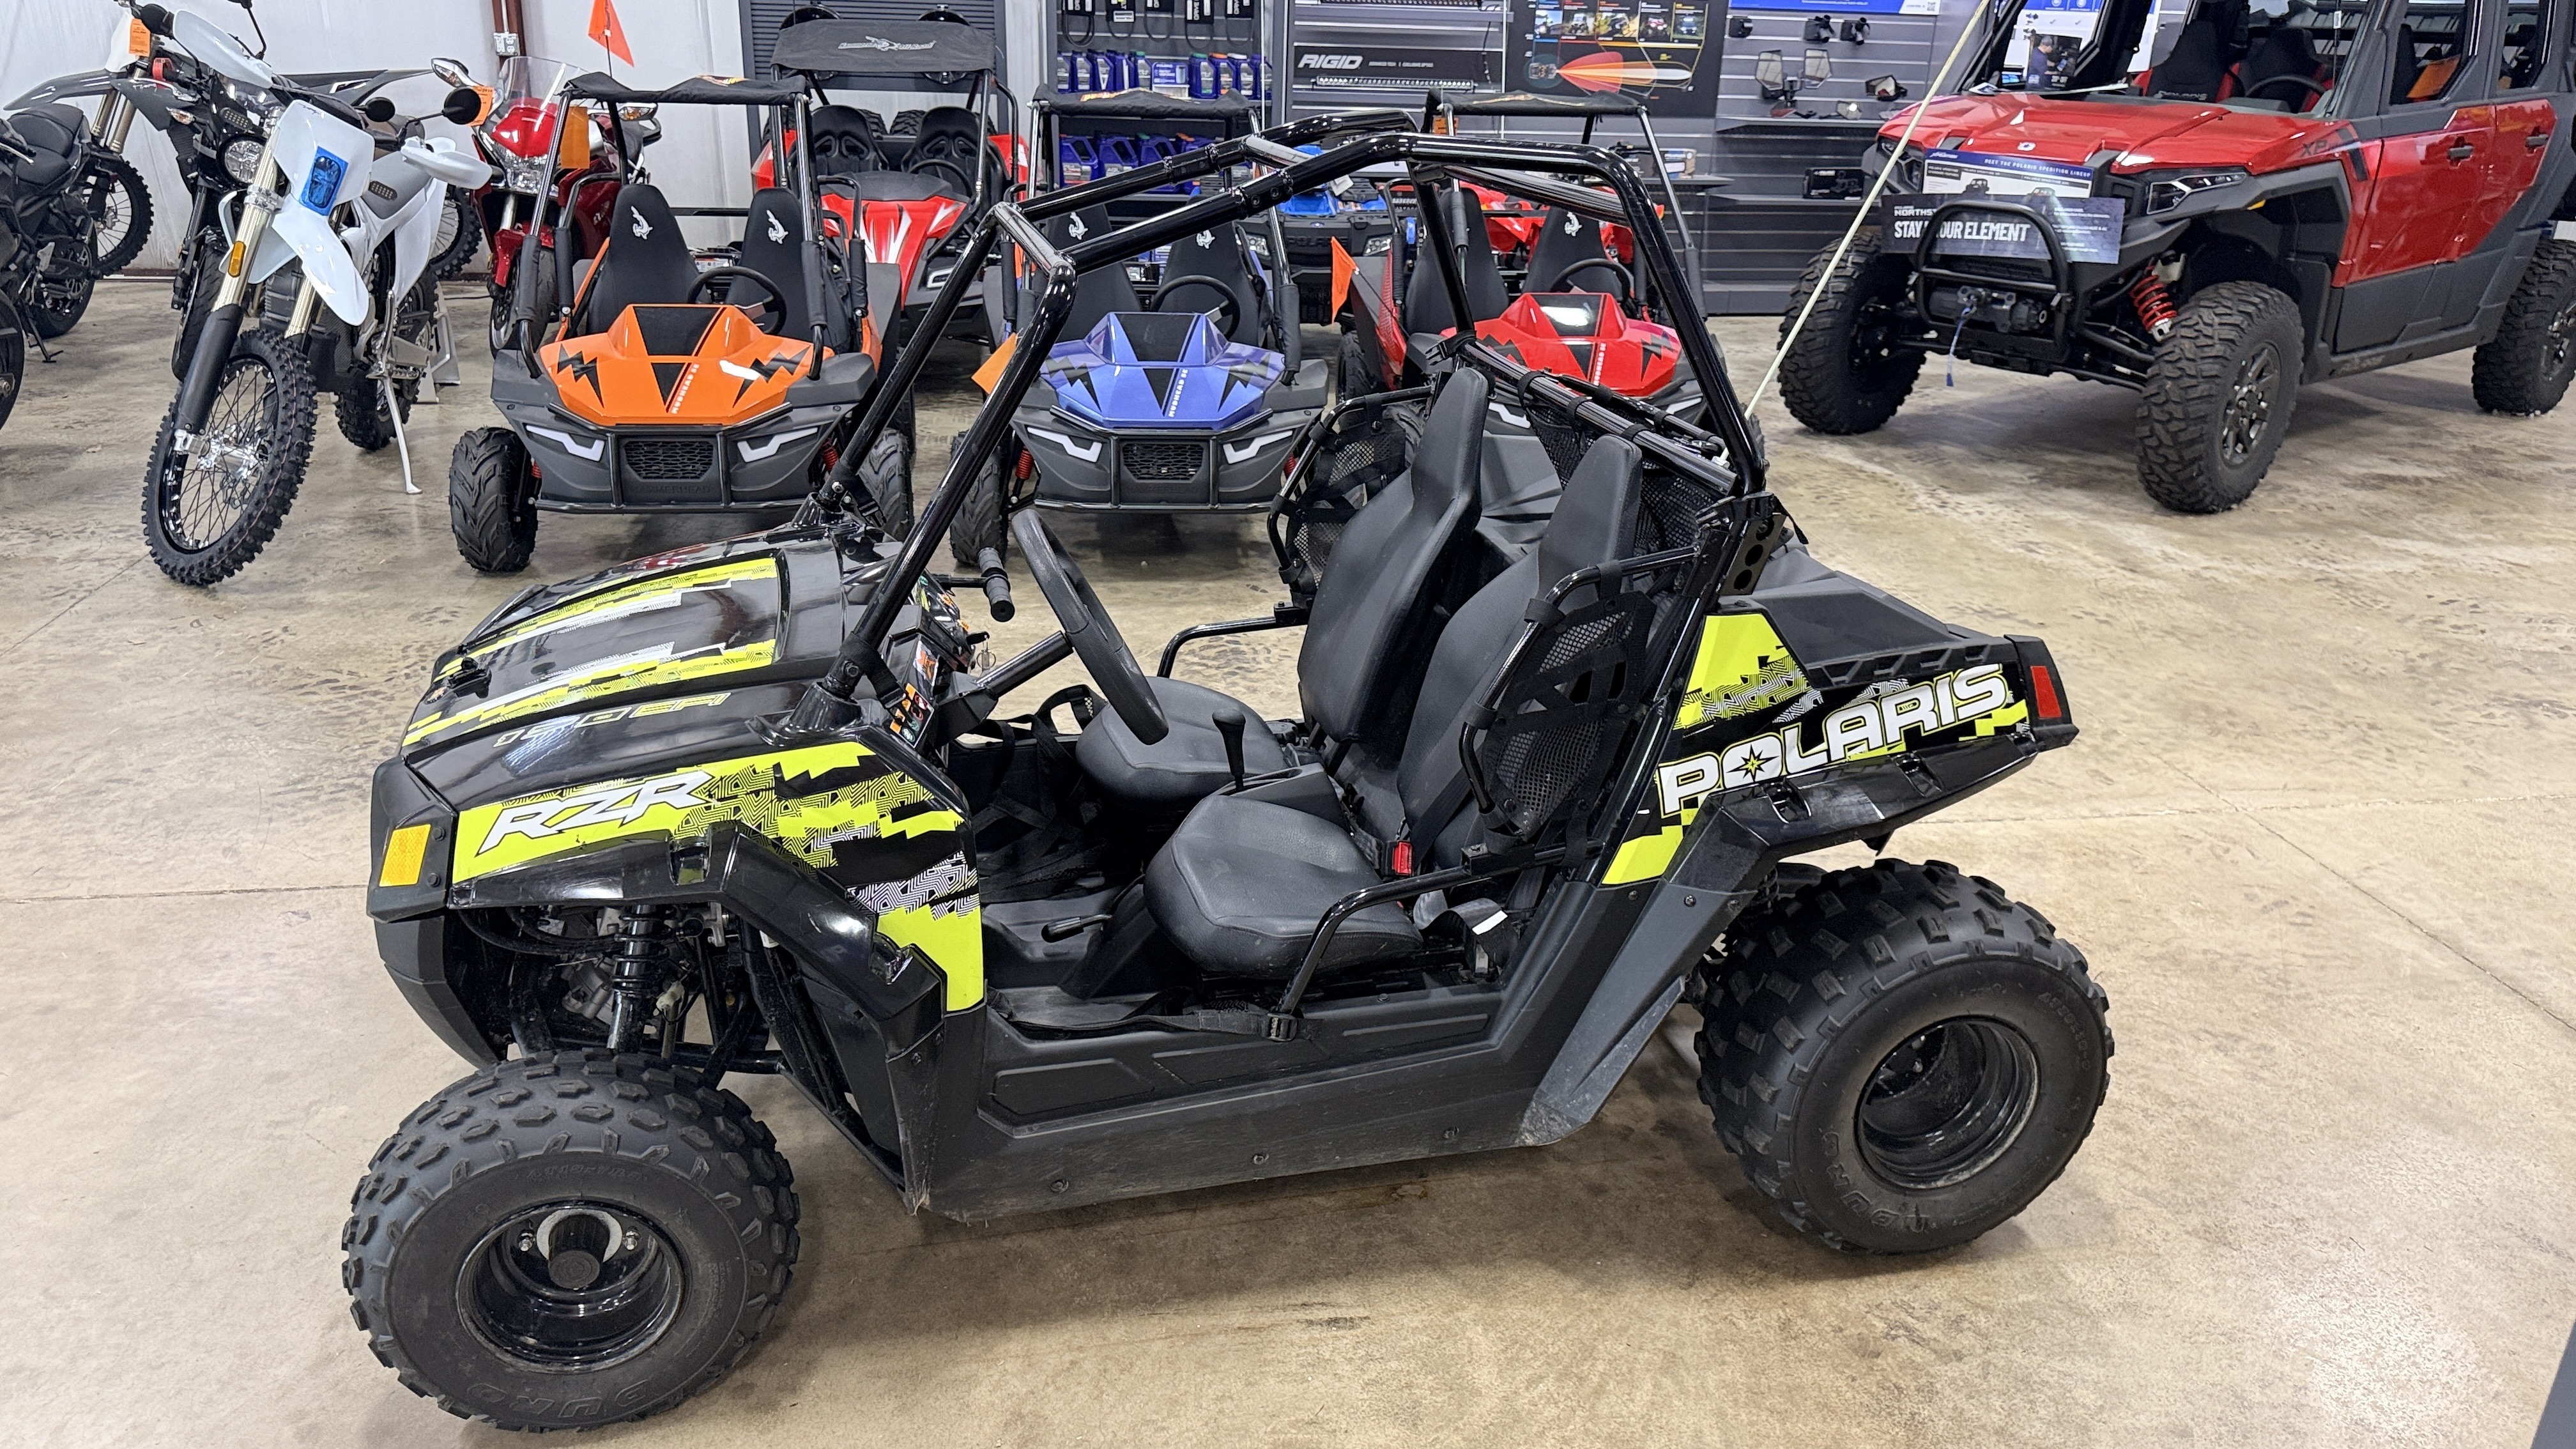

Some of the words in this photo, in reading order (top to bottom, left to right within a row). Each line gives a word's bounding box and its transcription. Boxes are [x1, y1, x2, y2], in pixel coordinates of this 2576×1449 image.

[1298, 54, 1363, 69] RIGID
[2301, 139, 2327, 157] XP
[1894, 220, 1922, 238] STAY
[1936, 222, 1962, 240] OUR
[1963, 222, 2030, 241] ELEMENT
[629, 692, 732, 719] EFI
[1657, 663, 2009, 818] POLARIS
[474, 770, 715, 857] RZR
